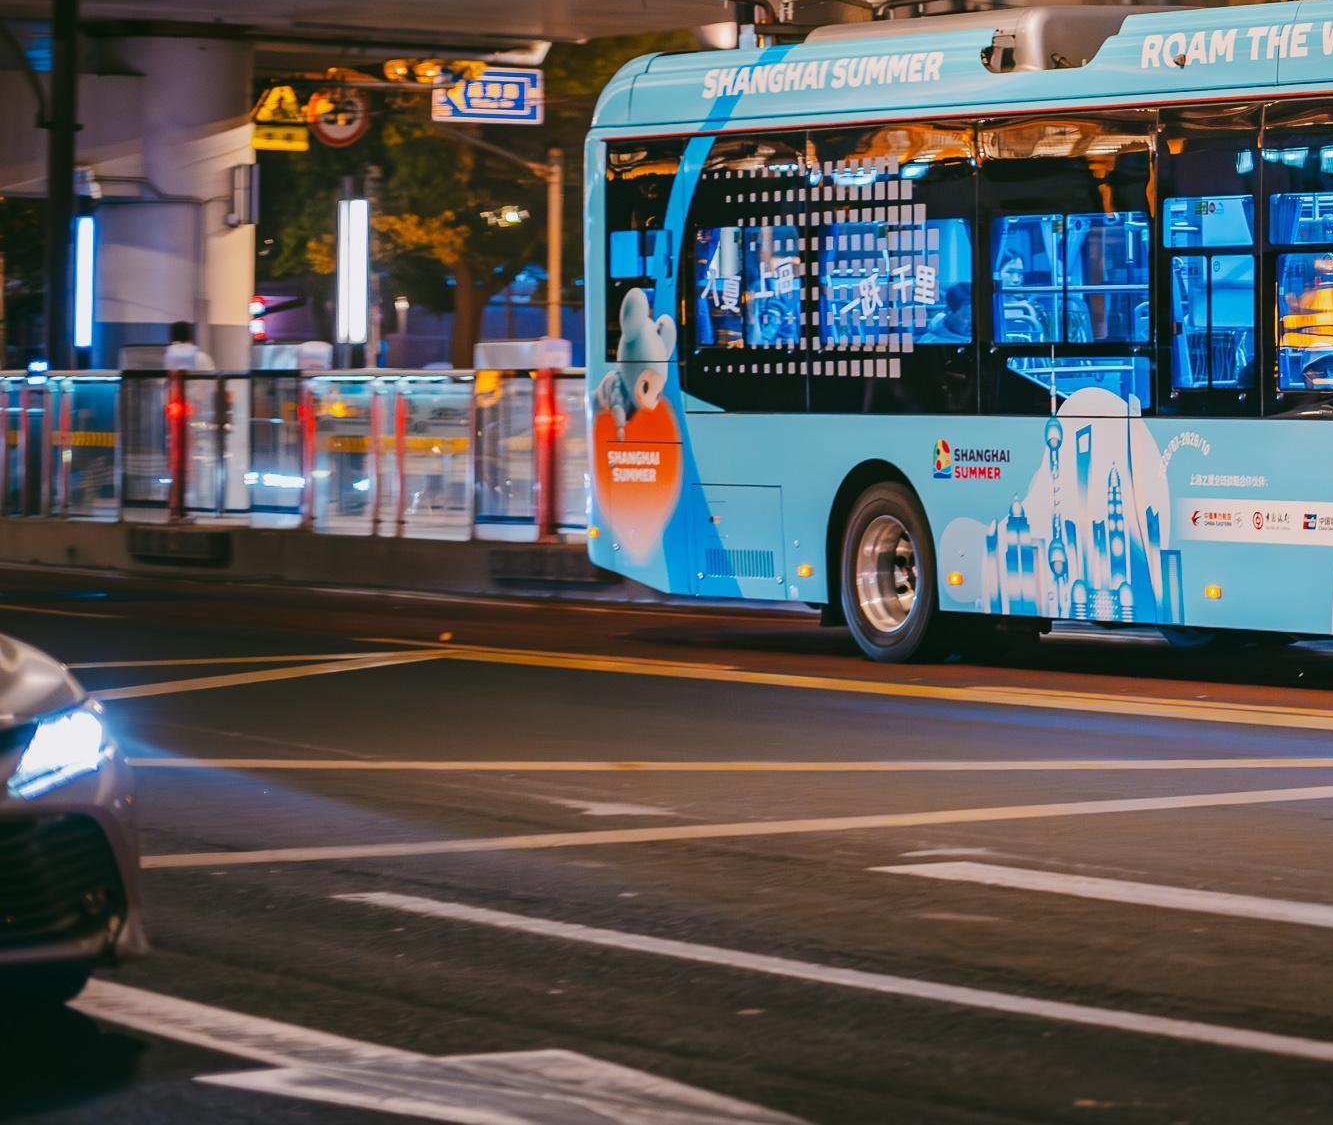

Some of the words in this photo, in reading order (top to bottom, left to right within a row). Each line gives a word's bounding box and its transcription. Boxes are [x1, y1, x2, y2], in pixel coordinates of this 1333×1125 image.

[1140, 28, 1236, 69] ROAM
[1246, 24, 1309, 60] THE
[701, 60, 830, 99] SHANGHAI
[830, 51, 945, 89] SUMMER
[953, 448, 1011, 463] SHANGHAI
[954, 465, 1001, 480] SUMMER
